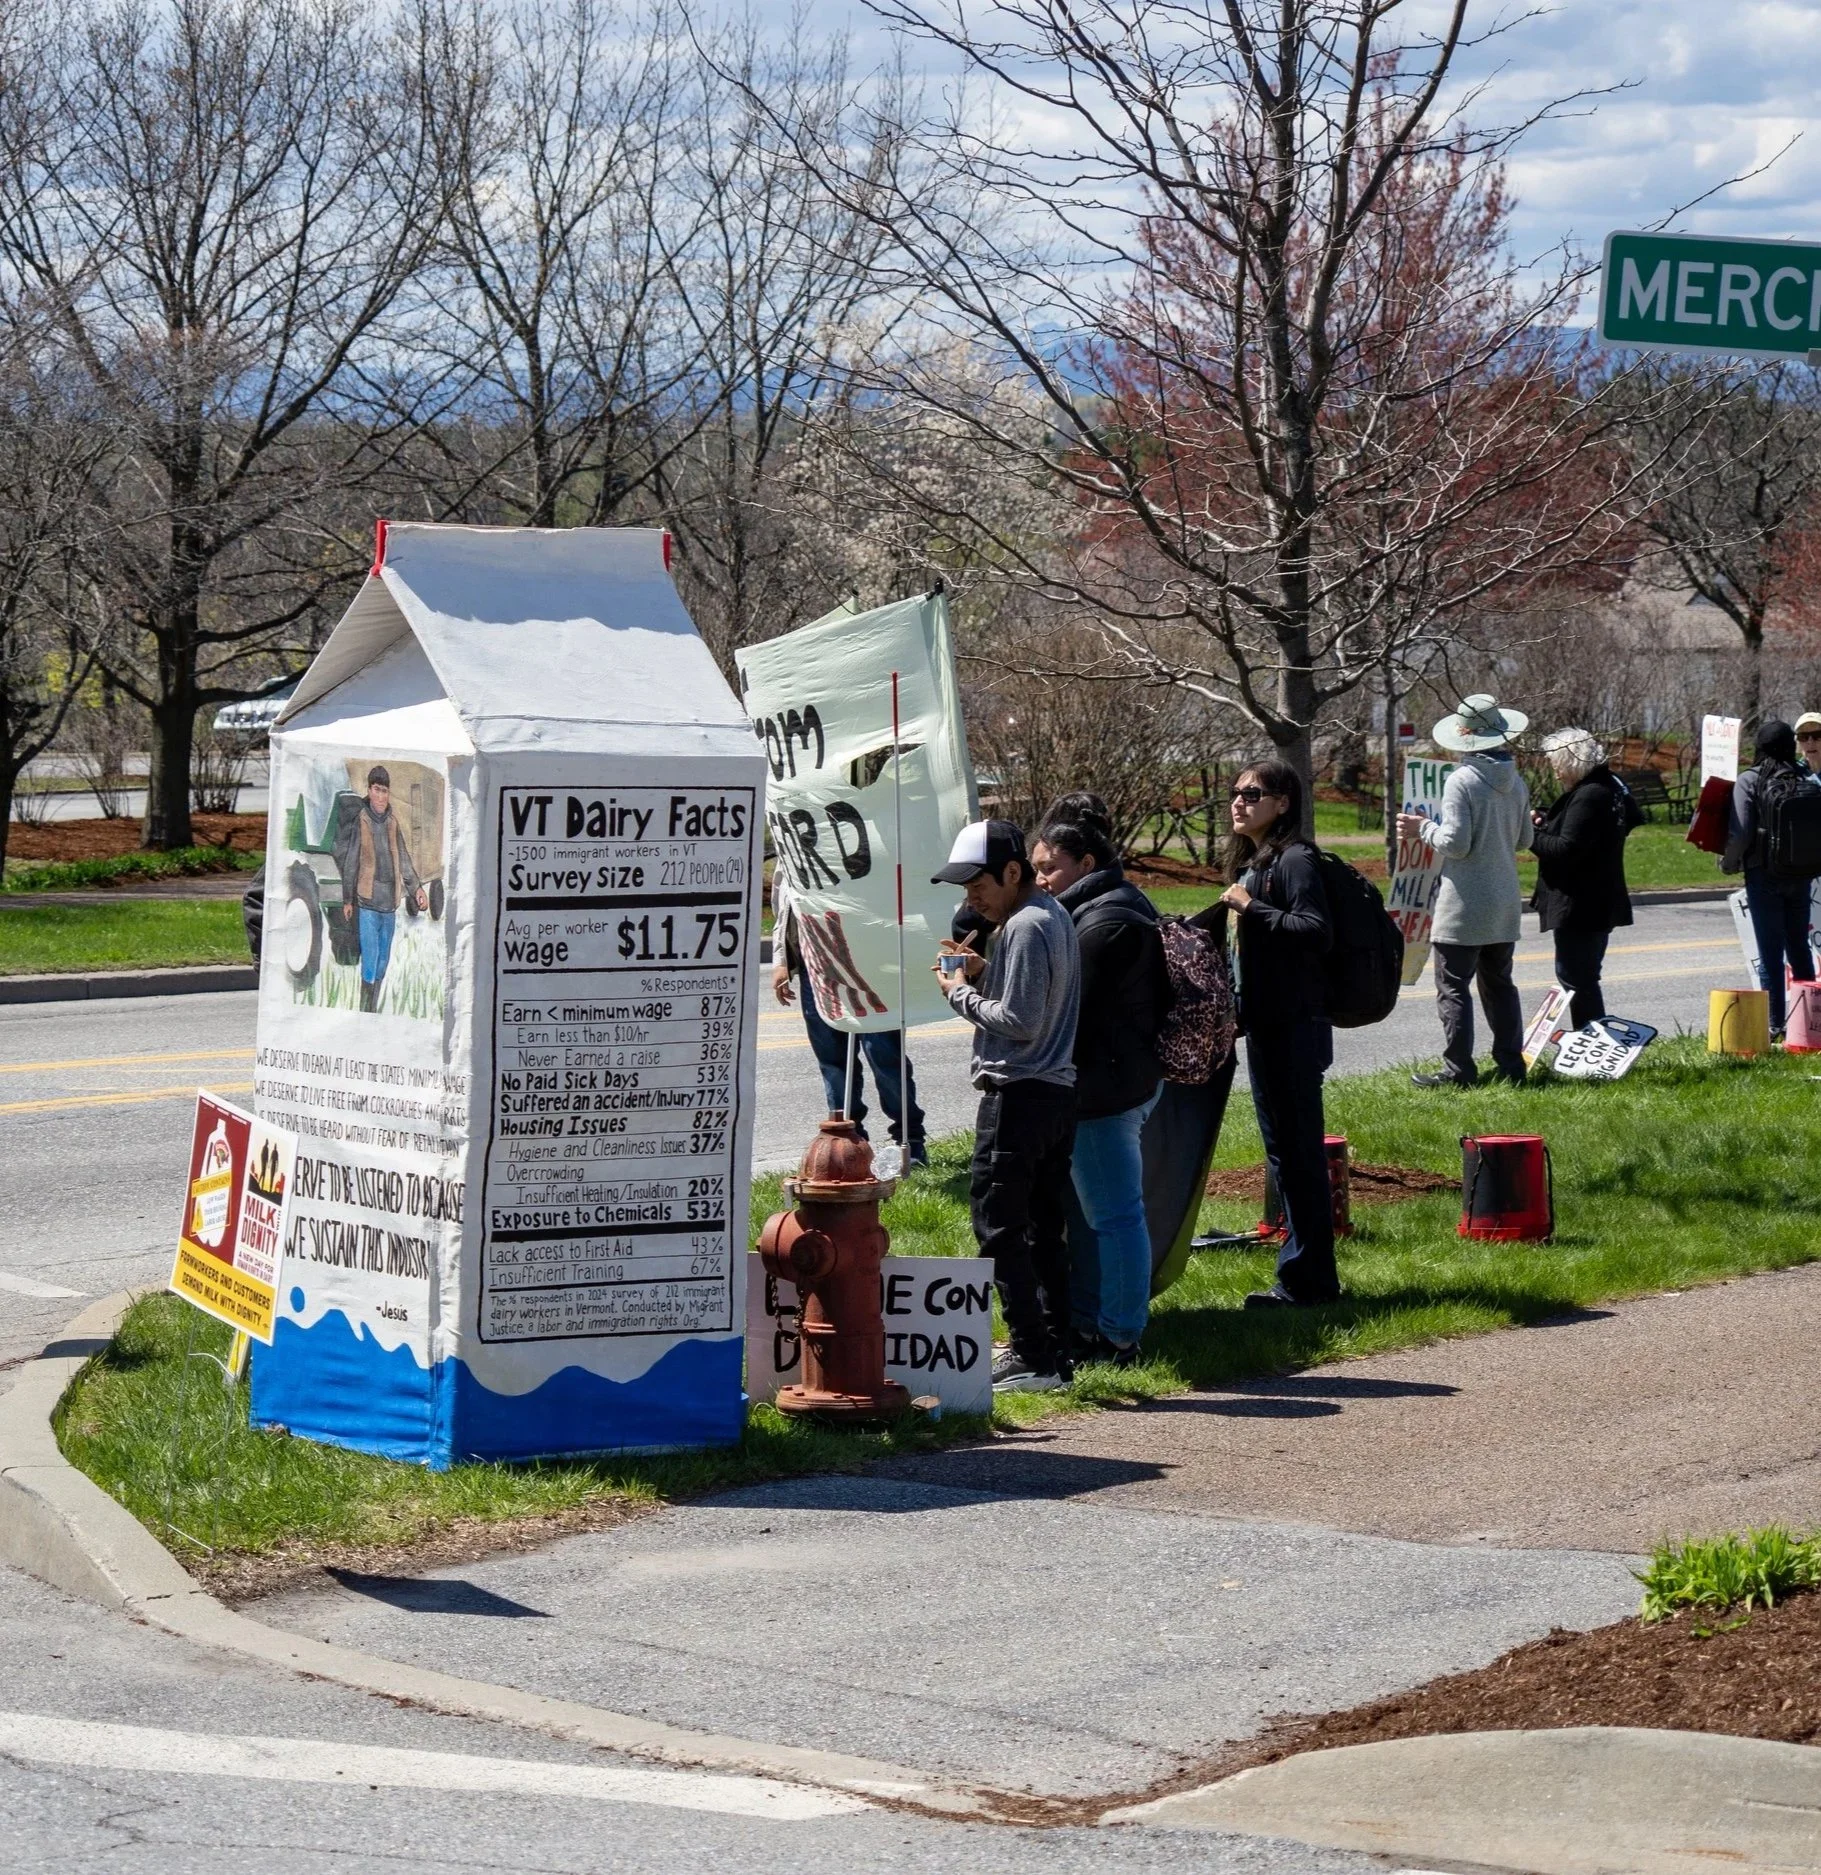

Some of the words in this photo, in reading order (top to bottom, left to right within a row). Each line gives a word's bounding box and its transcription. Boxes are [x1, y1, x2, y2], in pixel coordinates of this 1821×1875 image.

[510, 796, 553, 836] VT
[566, 796, 653, 840] Dairy
[669, 796, 745, 838] Facts
[554, 846, 609, 863] immigrant
[615, 845, 660, 857] workers
[669, 844, 678, 856] in
[683, 843, 698, 856] VT
[508, 864, 592, 893] Survey
[660, 861, 685, 886] 212
[505, 919, 531, 939] Avg
[538, 922, 560, 938] per
[565, 917, 609, 935] worker
[617, 912, 740, 961] $11.75
[502, 1003, 541, 1022] Earn
[563, 1004, 629, 1021] minimum
[632, 1002, 672, 1020] wage
[701, 996, 736, 1017] 87%
[518, 1027, 549, 1044] Earn
[555, 1027, 578, 1043] less
[583, 1026, 610, 1043] than
[615, 1024, 649, 1044] $10/hr
[702, 1020, 734, 1040] 39%
[518, 1049, 558, 1067] Never
[565, 1048, 610, 1067] Earned
[617, 1052, 624, 1066] a
[631, 1050, 660, 1065] raise
[701, 1043, 732, 1061] 36%
[1559, 1029, 1600, 1068] LECHE
[1585, 1041, 1610, 1065] CON
[257, 1048, 268, 1067] WE
[270, 1049, 299, 1071] DESERVE
[302, 1053, 310, 1072] TO
[311, 1054, 331, 1075] EARN
[332, 1057, 344, 1077] AT
[346, 1059, 365, 1080] LEAST
[368, 1063, 378, 1082] THE
[502, 1073, 521, 1091] No
[526, 1071, 557, 1090] Paid
[565, 1070, 597, 1089] Sick
[604, 1070, 639, 1089] Days
[697, 1064, 730, 1083] 53%
[255, 1080, 265, 1097] WE
[268, 1080, 299, 1103] DESERVE
[301, 1085, 309, 1103] TO
[309, 1087, 326, 1107] LIVE
[328, 1089, 345, 1110] FREE
[347, 1092, 368, 1112] FROM
[371, 1095, 422, 1120] COCKROACHES
[501, 1093, 570, 1113] Suffered
[573, 1095, 590, 1110] an
[696, 1087, 729, 1106] 77%
[301, 1116, 309, 1134] TO
[310, 1117, 318, 1136] BE
[320, 1119, 343, 1139] HEARD
[345, 1125, 376, 1145] WITHOUT
[378, 1128, 396, 1148] FEAR
[400, 1131, 409, 1149] OF
[500, 1116, 563, 1136] Housing
[567, 1116, 628, 1135] Issues
[692, 1110, 729, 1129] 82%
[509, 1141, 557, 1161] Hygiene
[564, 1140, 587, 1158] and
[593, 1137, 656, 1156] Cleanliness
[660, 1136, 687, 1154] Issues
[690, 1132, 725, 1153] 37%
[507, 1164, 584, 1181] Overcrowding
[328, 1162, 340, 1202] TO
[342, 1165, 356, 1205] BE
[355, 1167, 403, 1214] LISTENED
[406, 1173, 421, 1217] TO
[516, 1185, 579, 1204] Insufficient
[582, 1182, 678, 1203] Heating/Insulation
[688, 1177, 723, 1197] 20%
[245, 1194, 277, 1229] MILK
[492, 1210, 571, 1230] Exposure
[575, 1207, 590, 1224] to
[594, 1202, 672, 1223] Chemicals
[687, 1200, 725, 1220] 53%
[241, 1217, 278, 1259] DIGNITY
[285, 1216, 306, 1260] WE
[309, 1217, 359, 1269] SUSTAIN
[362, 1224, 384, 1273] THIS
[489, 1246, 519, 1263] Lack
[525, 1244, 564, 1261] access
[569, 1242, 580, 1259] to
[613, 1238, 633, 1256] Aid
[692, 1236, 723, 1254] 43%
[489, 1264, 566, 1287] Insufficient
[572, 1264, 623, 1280] Training
[690, 1257, 721, 1275] 67%
[204, 1285, 219, 1304] MILK
[220, 1293, 236, 1312] WITH
[236, 1303, 262, 1327] DIGNITY
[220, 1273, 233, 1290] AND
[233, 1281, 271, 1311] CUSTOMERS
[521, 1291, 573, 1306] respondents
[576, 1290, 585, 1301] in
[612, 1289, 644, 1300] survey
[650, 1285, 659, 1298] of
[666, 1285, 679, 1298] 212
[683, 1284, 725, 1300] immigrant
[924, 1277, 992, 1316] CON
[491, 1308, 516, 1322] dairy
[520, 1306, 560, 1319] workers
[565, 1305, 573, 1317] in
[576, 1302, 618, 1316] Vermont.
[622, 1300, 672, 1313] Conducted
[675, 1301, 685, 1314] by
[689, 1299, 724, 1317] Migrant
[528, 1322, 534, 1332] a
[537, 1321, 561, 1332] labor
[565, 1319, 584, 1331] and
[588, 1315, 645, 1331] immigration
[649, 1315, 678, 1329] rights
